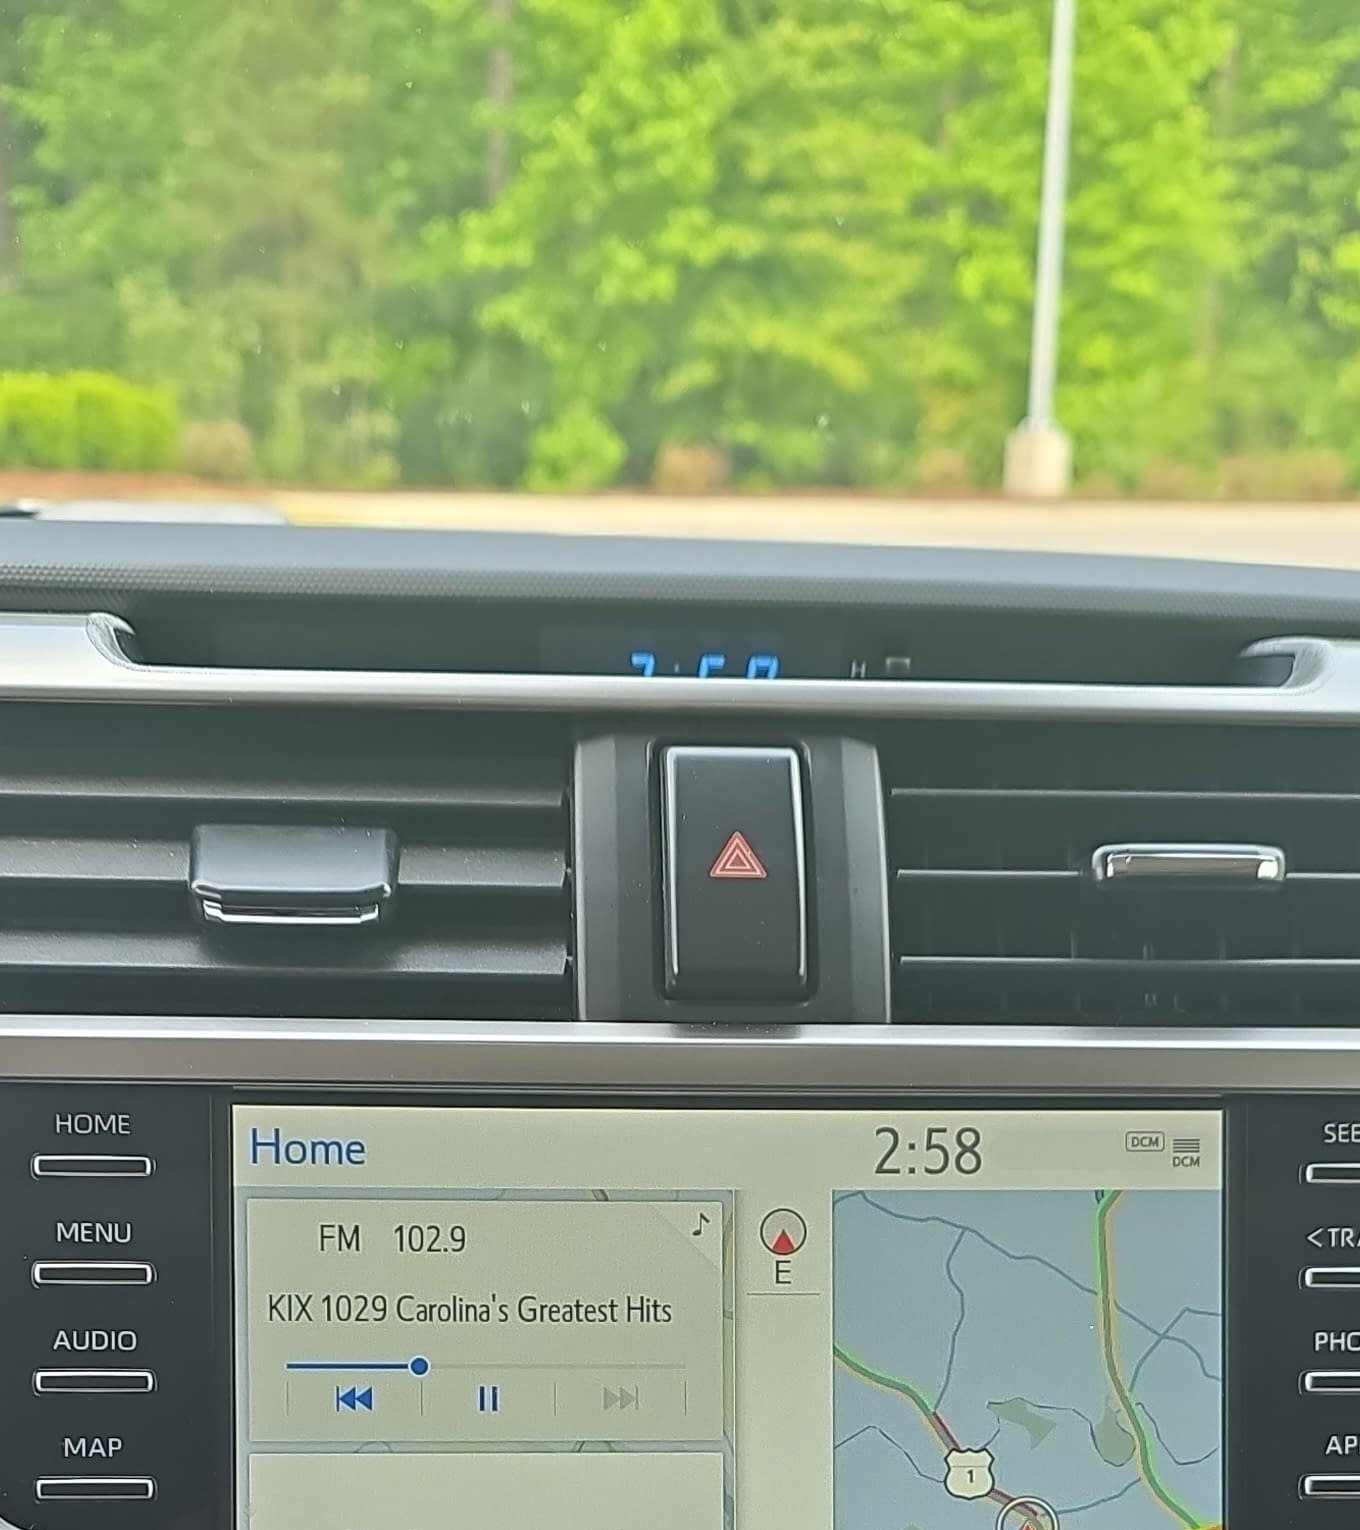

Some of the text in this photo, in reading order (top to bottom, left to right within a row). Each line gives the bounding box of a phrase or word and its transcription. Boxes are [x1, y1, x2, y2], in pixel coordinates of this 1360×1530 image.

[55, 1113, 131, 1135] HOME
[251, 1127, 366, 1165] Home
[874, 1126, 982, 1175] 2:58
[1131, 1136, 1160, 1148] DCM
[1172, 1155, 1201, 1168] DCM
[56, 1222, 131, 1243] MENU
[320, 1224, 466, 1253] FM 102.9
[775, 1259, 792, 1285] E
[268, 1293, 672, 1323] KIX 1029 Carolina's Greatest Hits
[53, 1330, 137, 1351] AUDIO
[64, 1437, 122, 1458] MAP
[965, 1469, 976, 1485] 1
